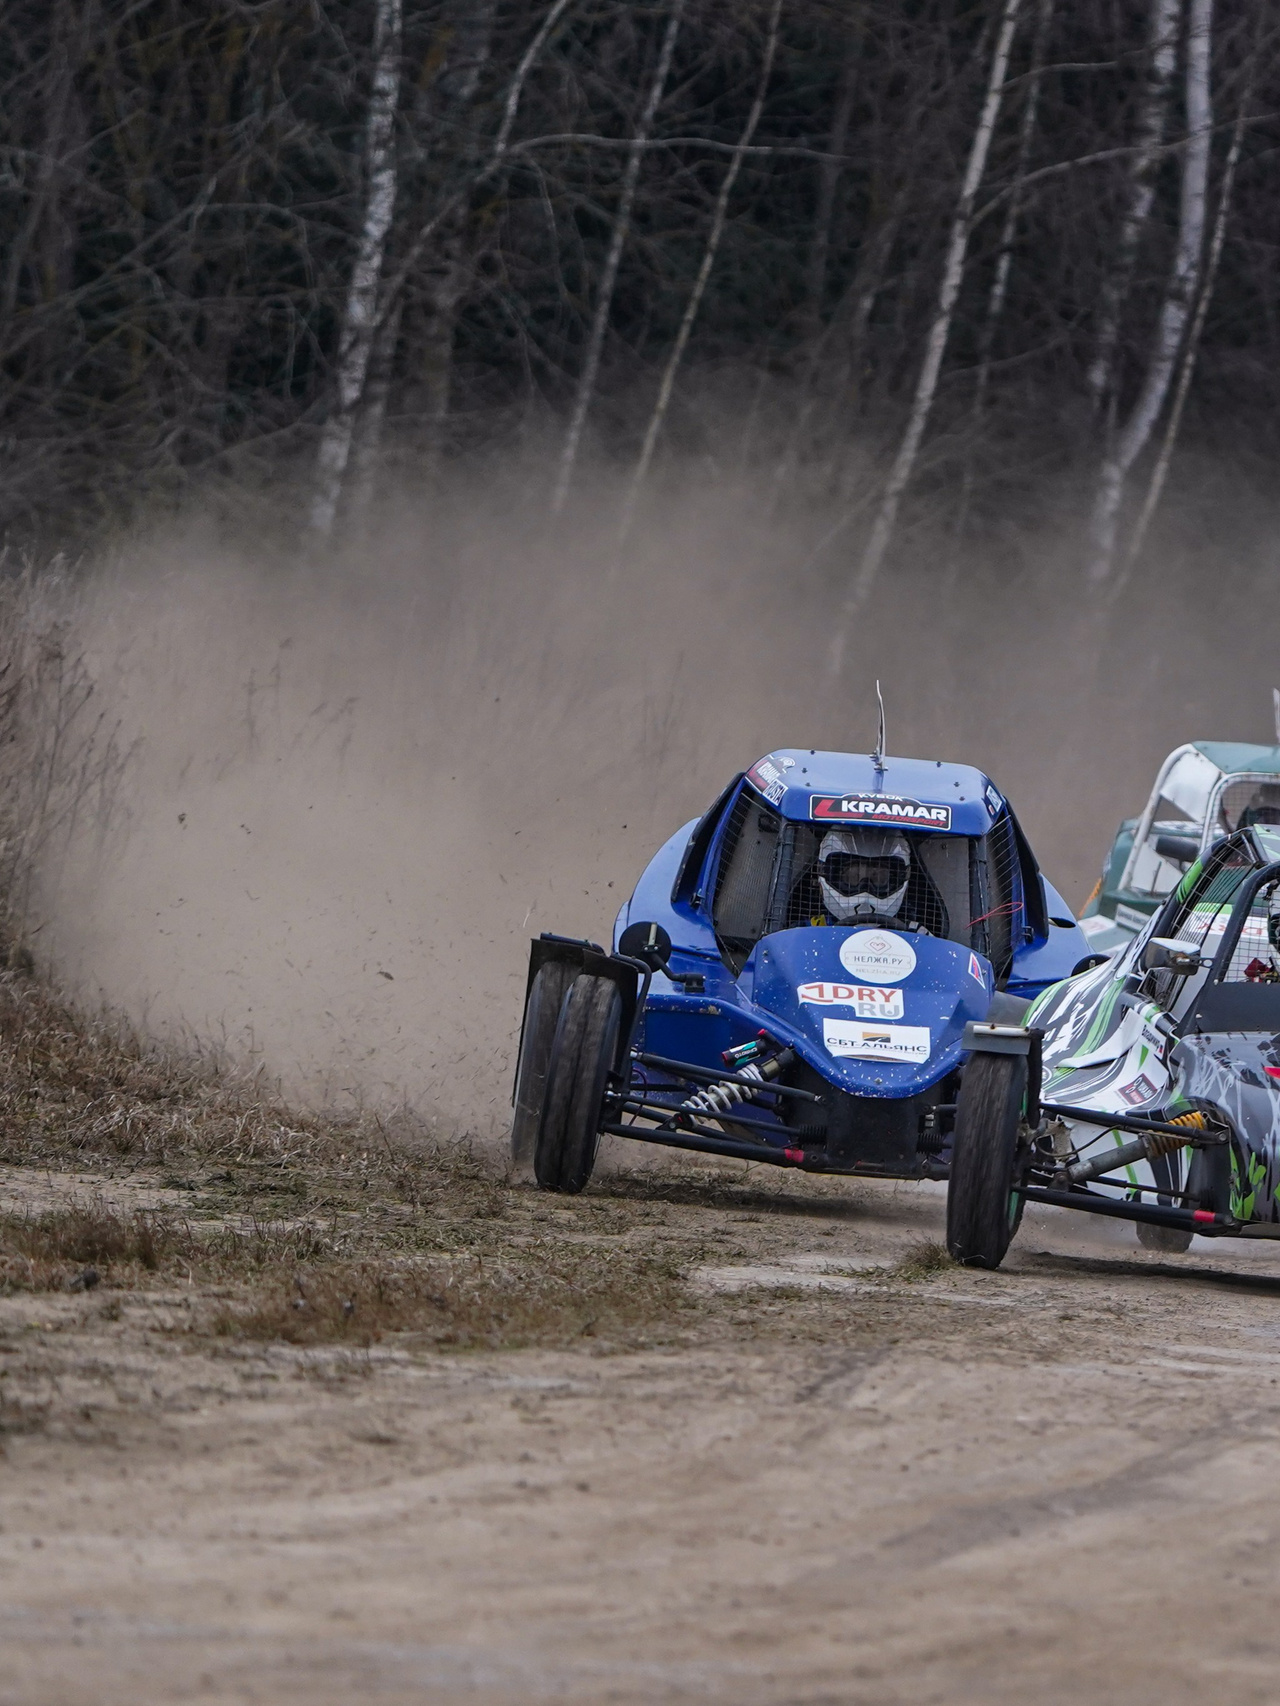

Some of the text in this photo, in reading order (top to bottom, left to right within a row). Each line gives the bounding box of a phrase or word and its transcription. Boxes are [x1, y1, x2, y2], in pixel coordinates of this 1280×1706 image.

[841, 800, 948, 821] KRAMAR
[871, 814, 946, 826] MOTORSPORT
[853, 955, 904, 965] НЕЛЖА.РУ
[801, 983, 897, 1003] 1DRY
